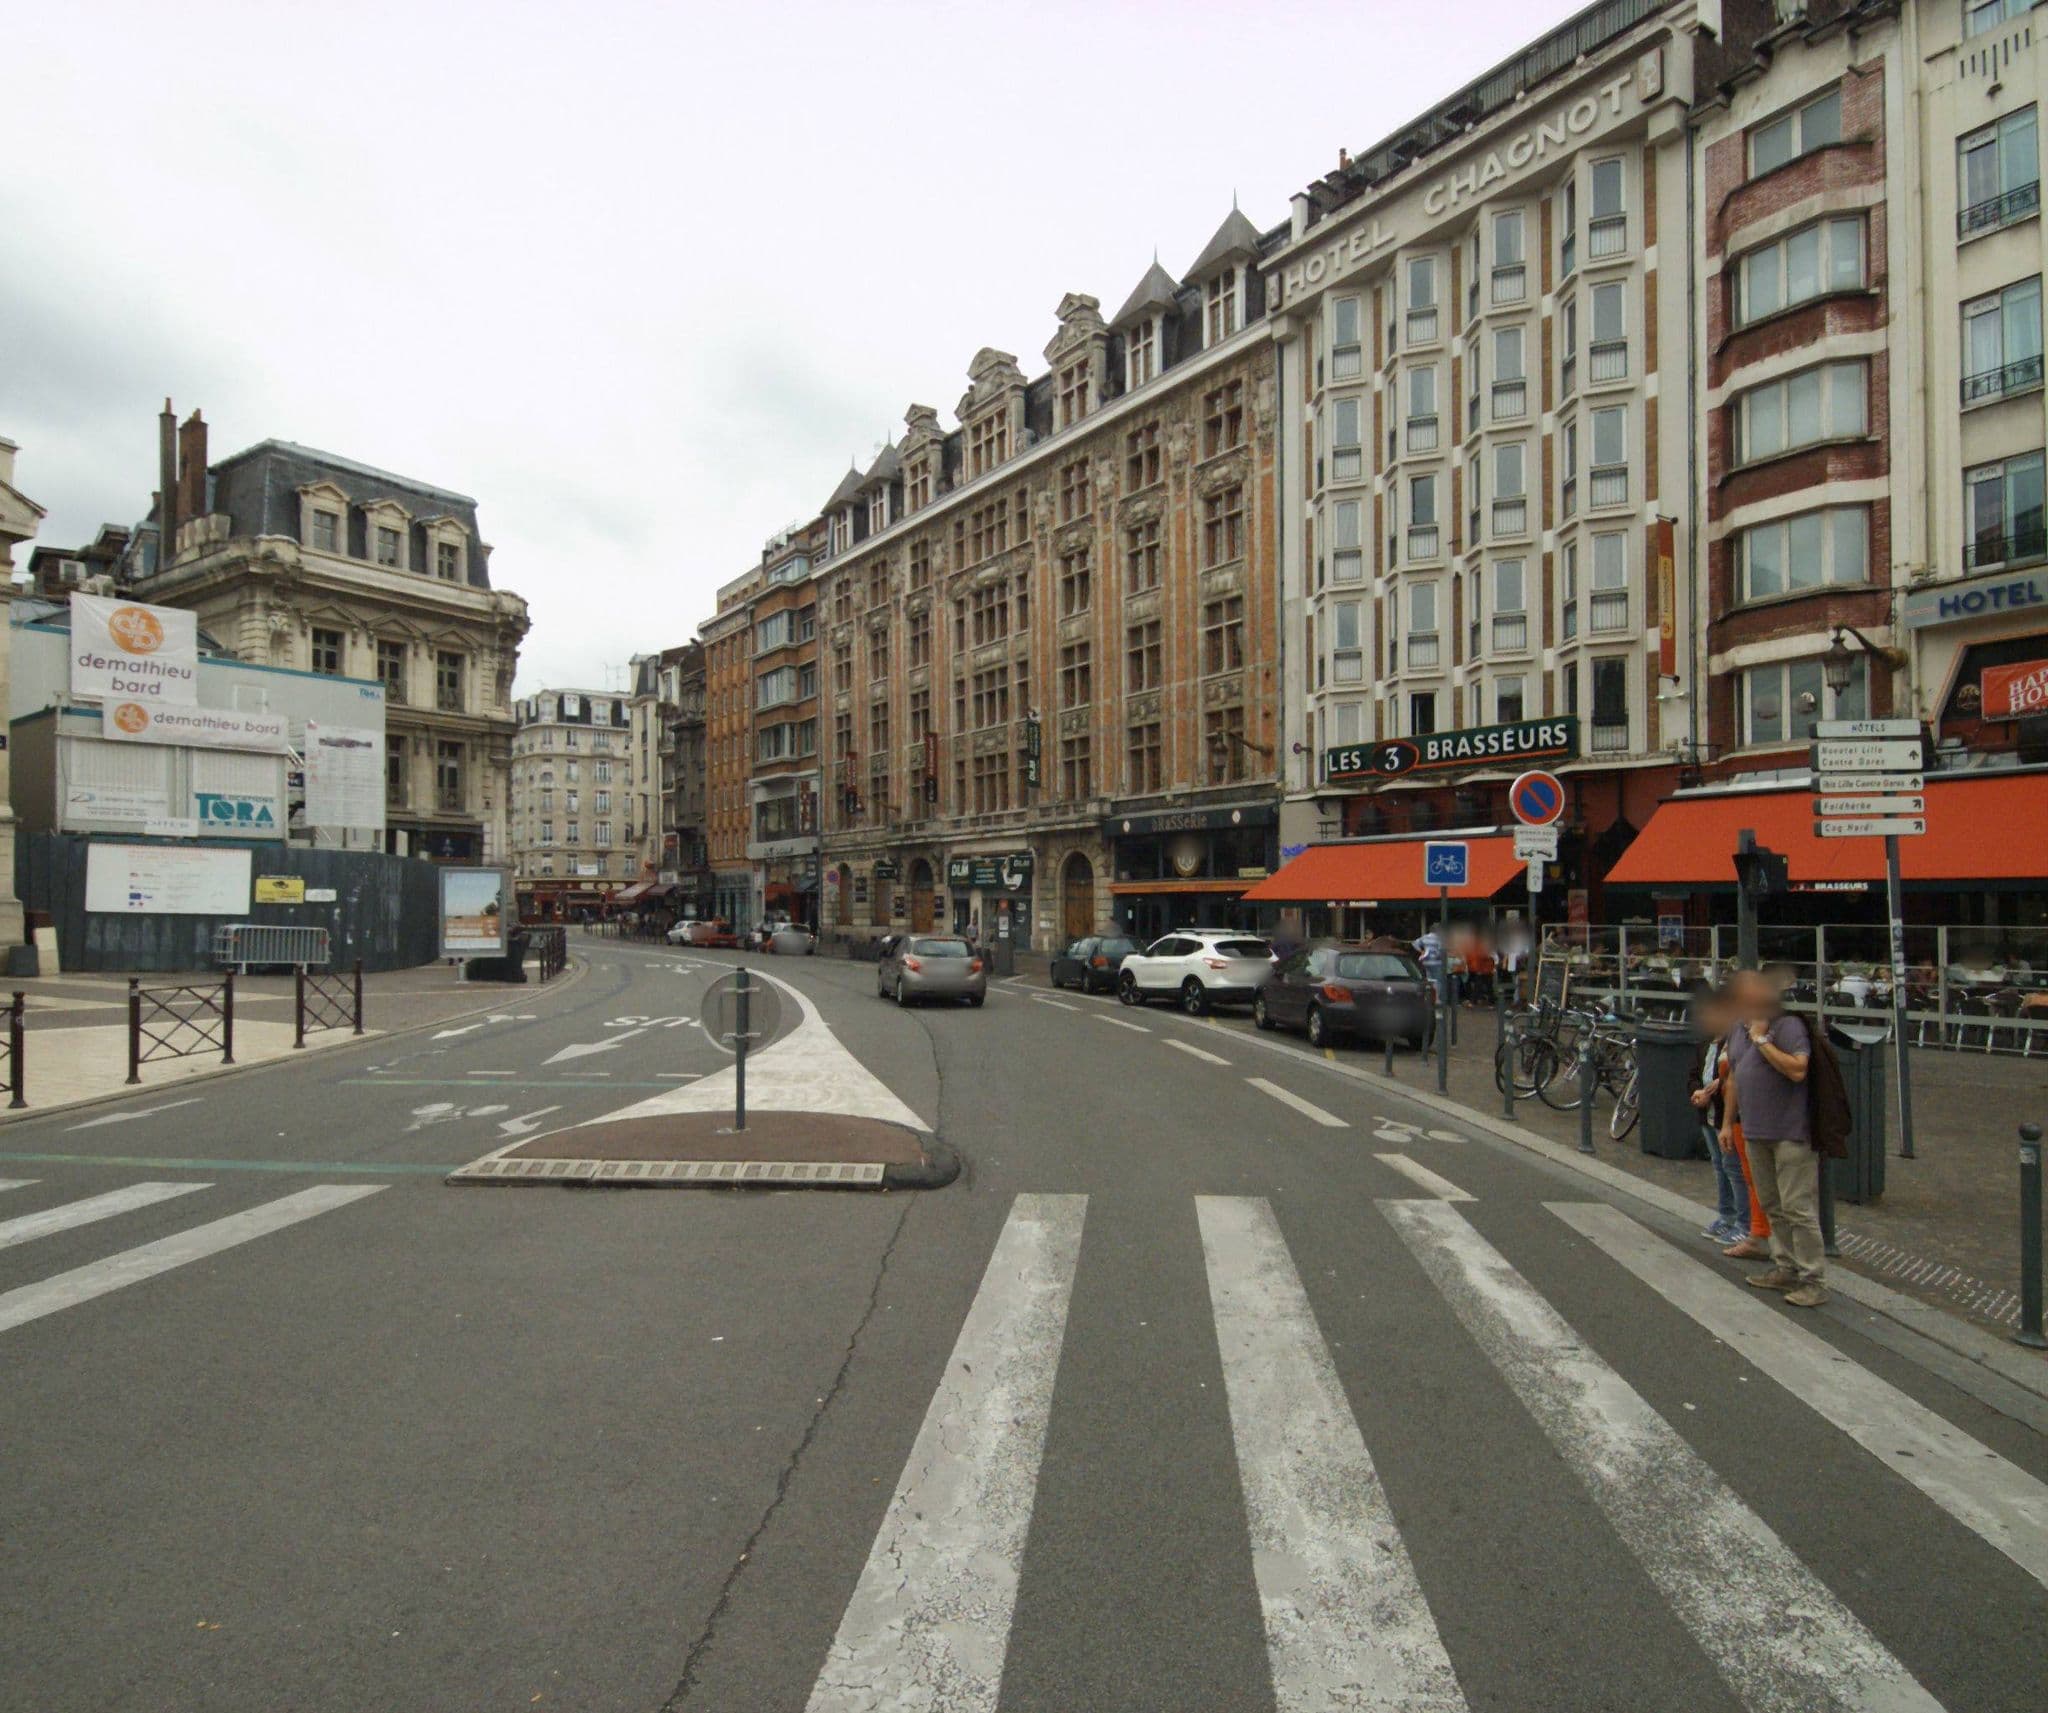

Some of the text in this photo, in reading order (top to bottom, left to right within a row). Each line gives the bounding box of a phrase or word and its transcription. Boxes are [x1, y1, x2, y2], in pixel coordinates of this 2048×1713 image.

[1286, 72, 1632, 298] HOTEL CHAGNOT
[1939, 580, 2043, 617] HOTEL
[78, 653, 192, 680] demathieu
[111, 677, 161, 695] bard
[154, 711, 280, 736] demathieu bard
[1328, 751, 1361, 772] LES
[1385, 747, 1399, 770] 3
[195, 793, 273, 821] TORA
